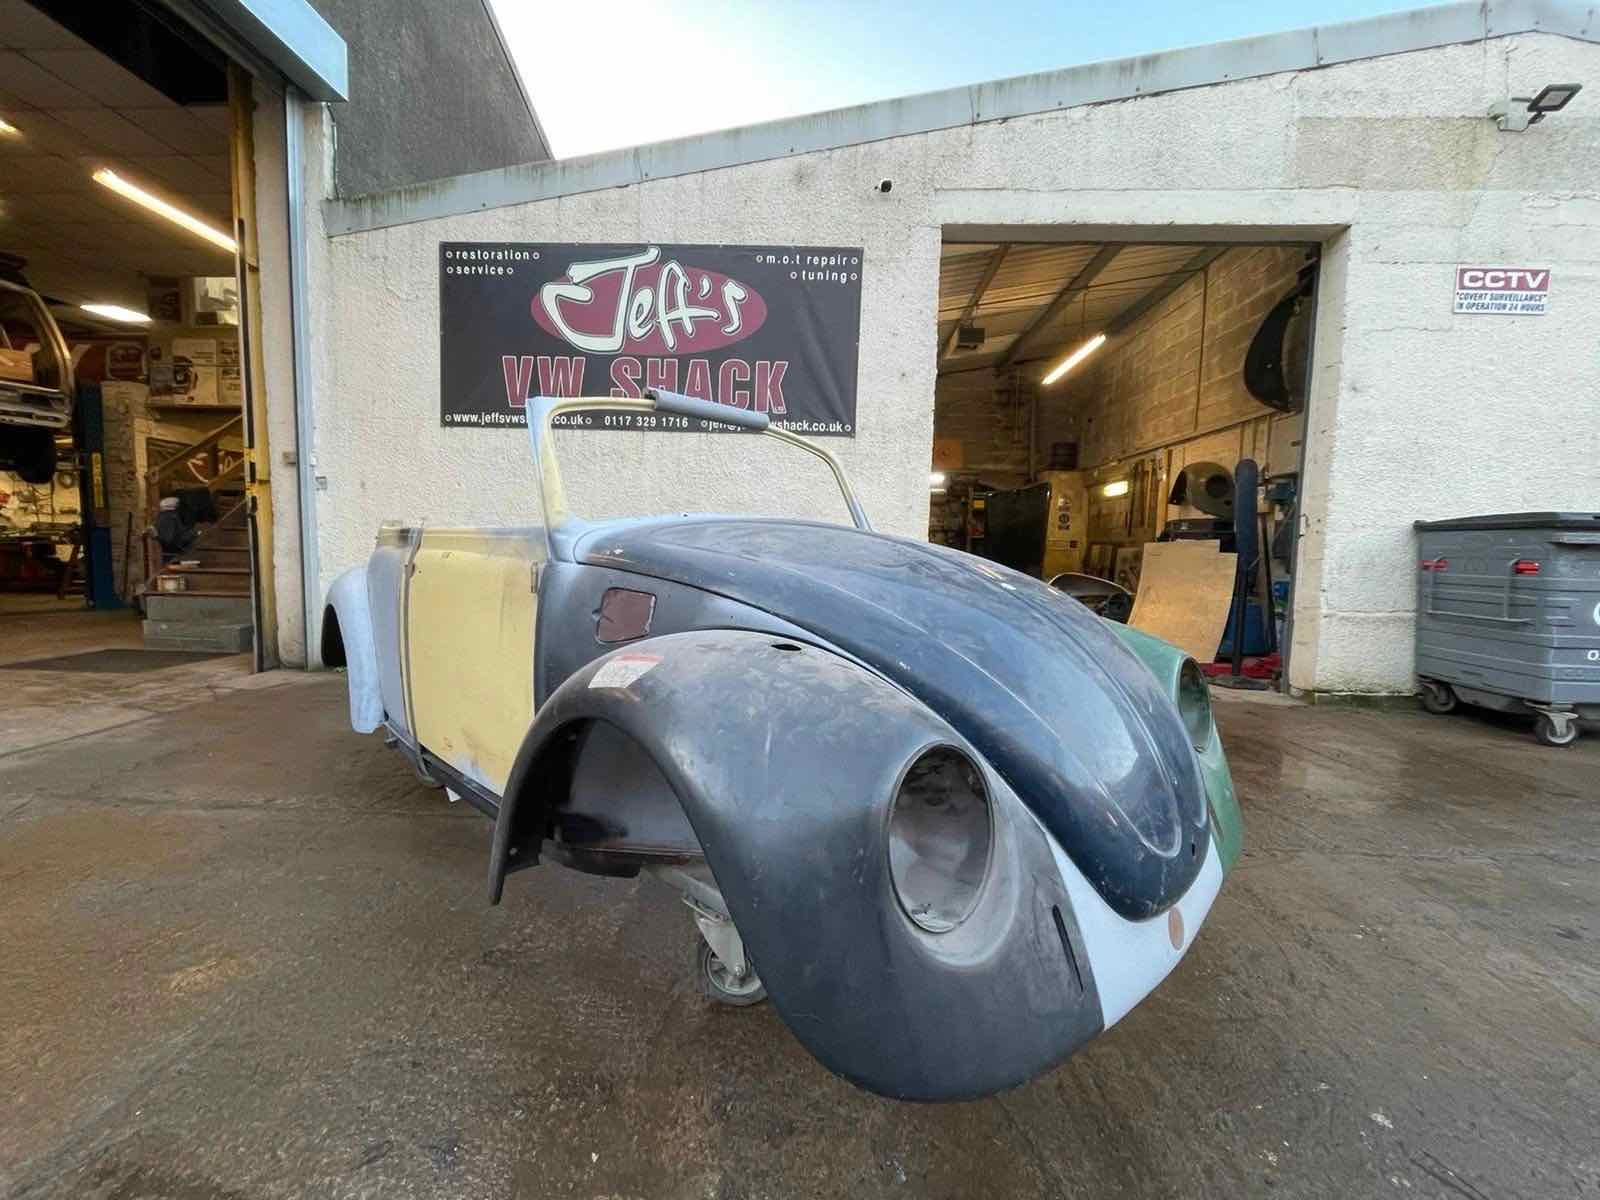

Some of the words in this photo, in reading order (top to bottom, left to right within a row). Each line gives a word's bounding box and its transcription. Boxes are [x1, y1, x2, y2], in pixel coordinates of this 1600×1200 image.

[456, 249, 529, 260] restoration
[766, 254, 800, 265] m.o.t
[807, 254, 847, 268] repair
[456, 264, 504, 275] service
[802, 270, 847, 284] tuning
[1463, 270, 1546, 289] CCTV
[541, 247, 747, 353] Jeff's
[1465, 302, 1507, 312] OPERATION
[502, 356, 586, 408] VW
[610, 357, 789, 415] SHACK
[453, 412, 584, 425] www.jeffsvws.co.uk
[604, 415, 632, 426] 0117
[636, 416, 656, 427] 329
[662, 417, 688, 428] 1716
